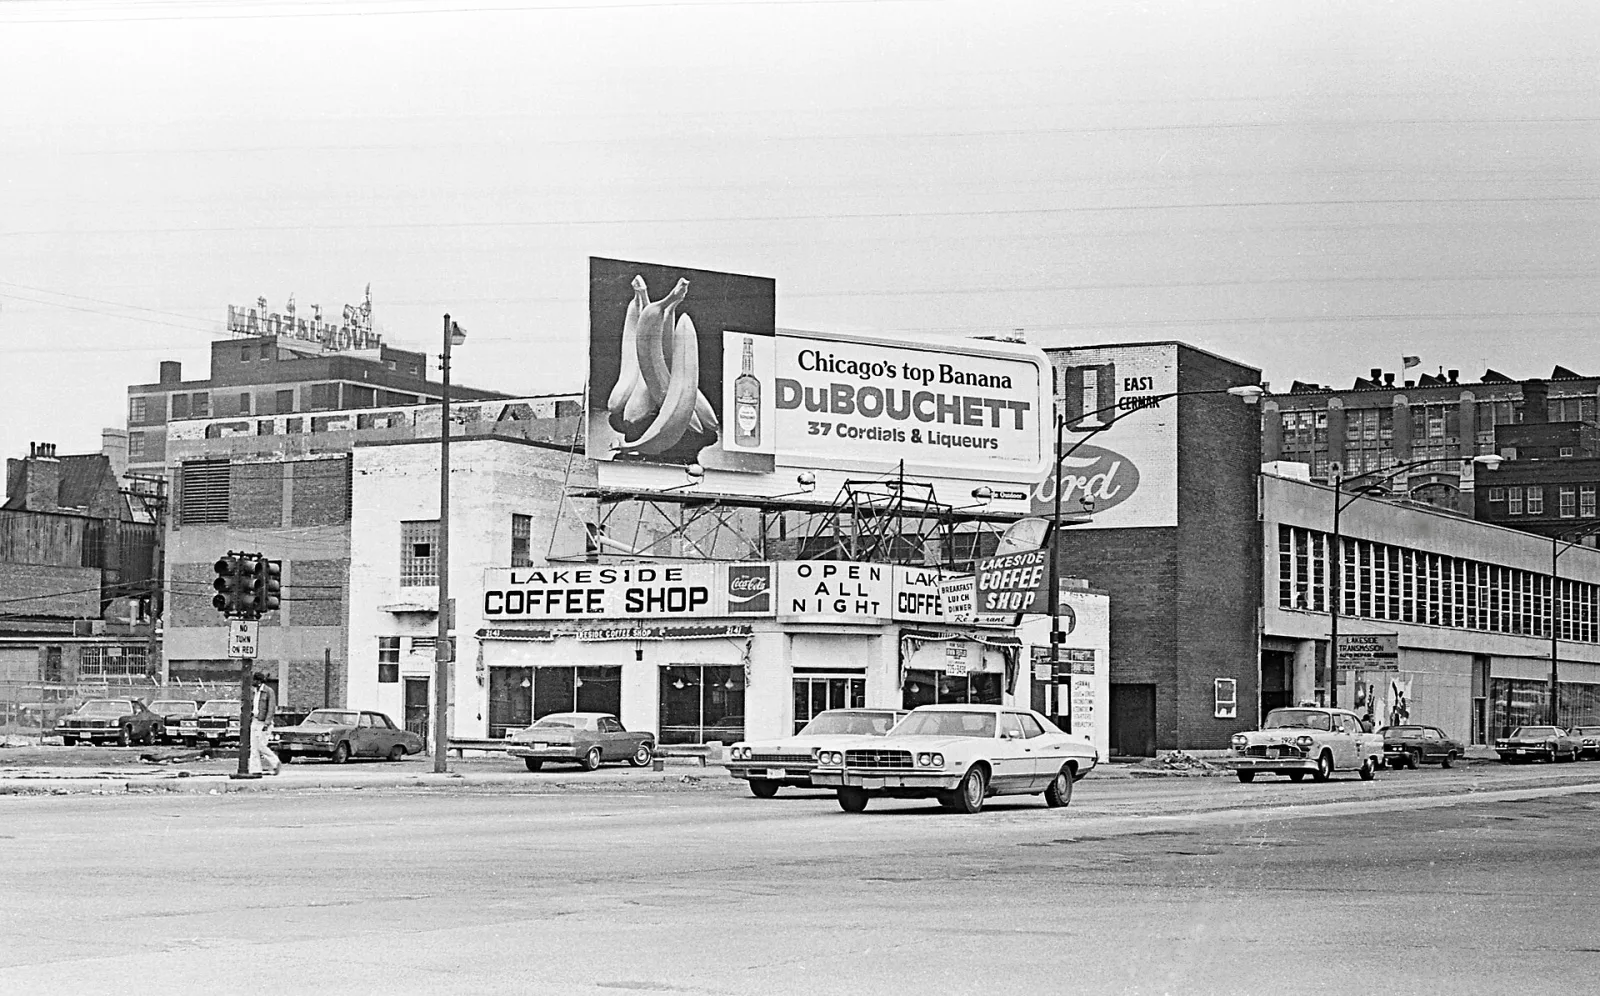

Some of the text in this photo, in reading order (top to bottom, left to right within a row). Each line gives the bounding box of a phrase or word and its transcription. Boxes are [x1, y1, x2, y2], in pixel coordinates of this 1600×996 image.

[798, 350, 1012, 389] Chicago's top Banana
[1124, 377, 1153, 391] EAST
[775, 377, 1030, 430] DuBOUCHETT
[1119, 395, 1160, 410] CERMAK
[807, 421, 998, 449] 37 Cordials & Liqueurs
[980, 551, 1045, 571] LAKESIDE
[511, 568, 682, 584] LAKESIDE
[797, 564, 880, 581] OPEN
[979, 565, 1044, 590] COFFEE
[814, 581, 868, 597] ALL
[941, 583, 973, 594] BREAKFAST
[485, 587, 708, 614] COFFEE SHOP
[793, 598, 880, 615] NIGHT
[948, 604, 972, 613] DINNER
[985, 591, 1035, 610] SHOP
[236, 635, 251, 643] TURN
[633, 629, 652, 637] SHOP
[726, 627, 742, 635] 2141
[242, 646, 254, 654] RED
